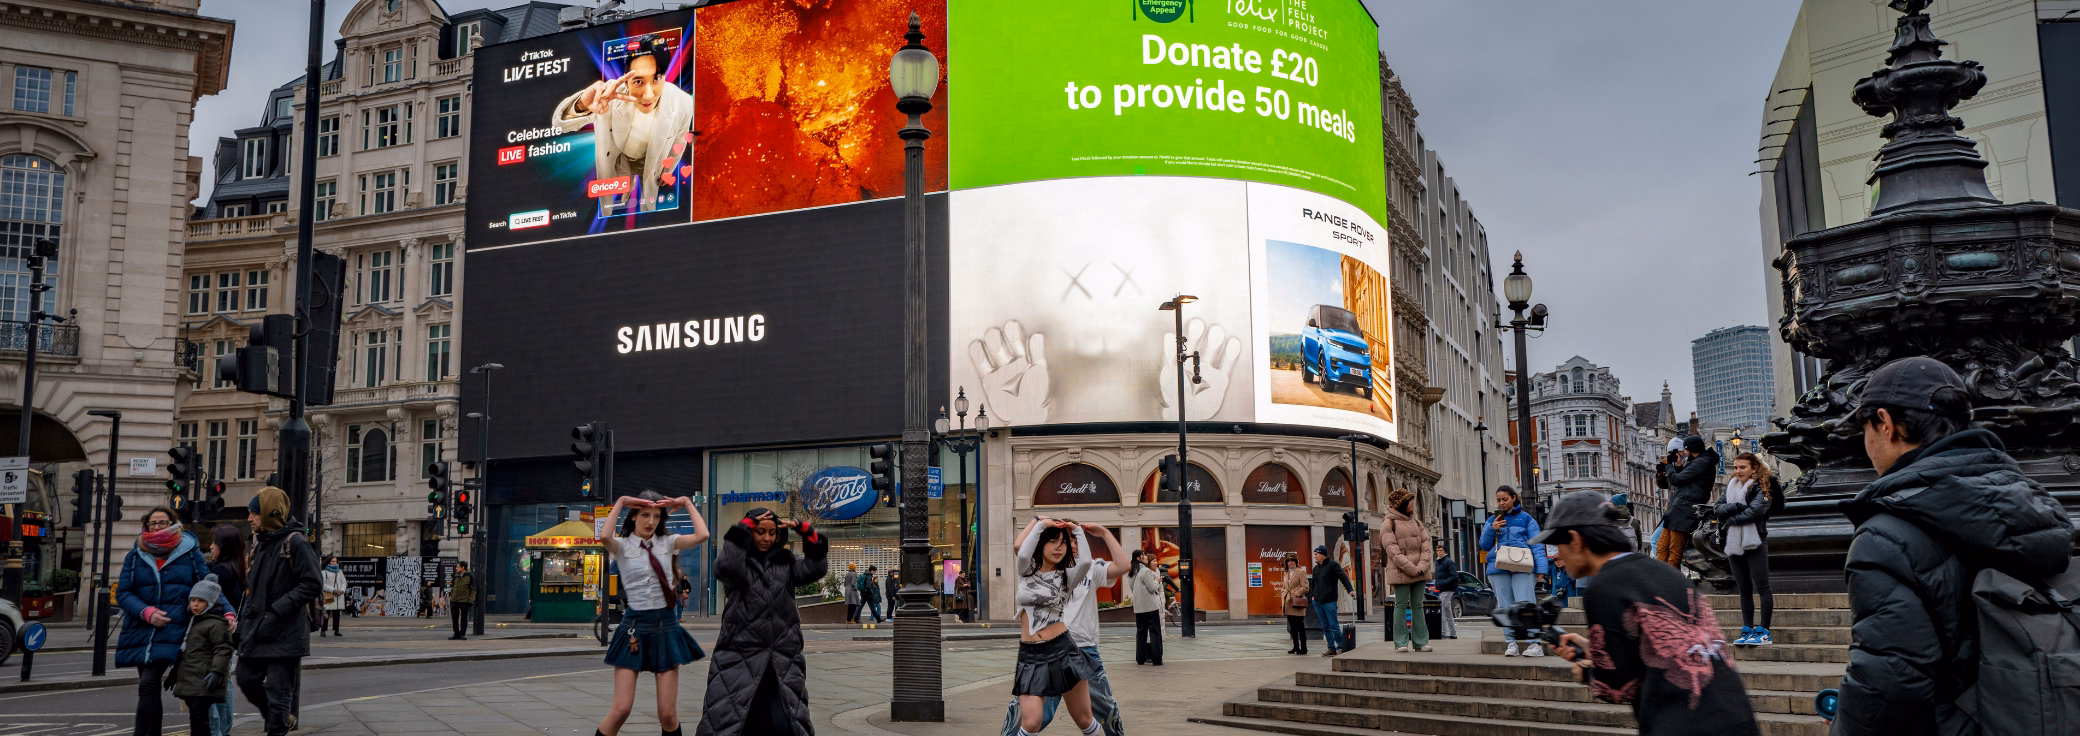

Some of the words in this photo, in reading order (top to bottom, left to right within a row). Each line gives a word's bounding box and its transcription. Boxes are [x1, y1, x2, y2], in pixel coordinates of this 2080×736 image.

[1150, 6, 1176, 14] Appeal
[1288, 8, 1314, 24] FELIX
[1253, 25, 1272, 33] FOOD
[1276, 29, 1288, 37] FOR
[1290, 34, 1307, 43] GOOD
[1310, 40, 1329, 51] CAUSES
[1289, 19, 1328, 40] PROJECT
[529, 49, 554, 60] TikTok
[1142, 34, 1262, 74] Donate
[1270, 49, 1319, 87] £20
[503, 64, 534, 83] LIVE
[536, 57, 571, 77] FEST
[1065, 81, 1102, 110] to
[1113, 78, 1246, 116] provide
[1255, 86, 1291, 120] 50
[1298, 101, 1356, 143] meals
[507, 125, 562, 143] Celebrate
[501, 149, 523, 162] LIVE
[528, 141, 571, 158] fashion
[591, 179, 628, 194] @rico9_c
[489, 220, 507, 229] Search
[521, 216, 534, 224] LIVE
[560, 211, 578, 219] TikTok
[1303, 208, 1348, 229] RANGE
[1350, 222, 1375, 244] ROVER
[1332, 231, 1363, 248] SPORT
[617, 314, 765, 354] SAMSUNG
[812, 474, 868, 510] Boots
[1057, 483, 1088, 494] Lindt
[1257, 482, 1281, 493] Lindt
[721, 490, 788, 506] pharmacy
[359, 564, 373, 572] TAP
